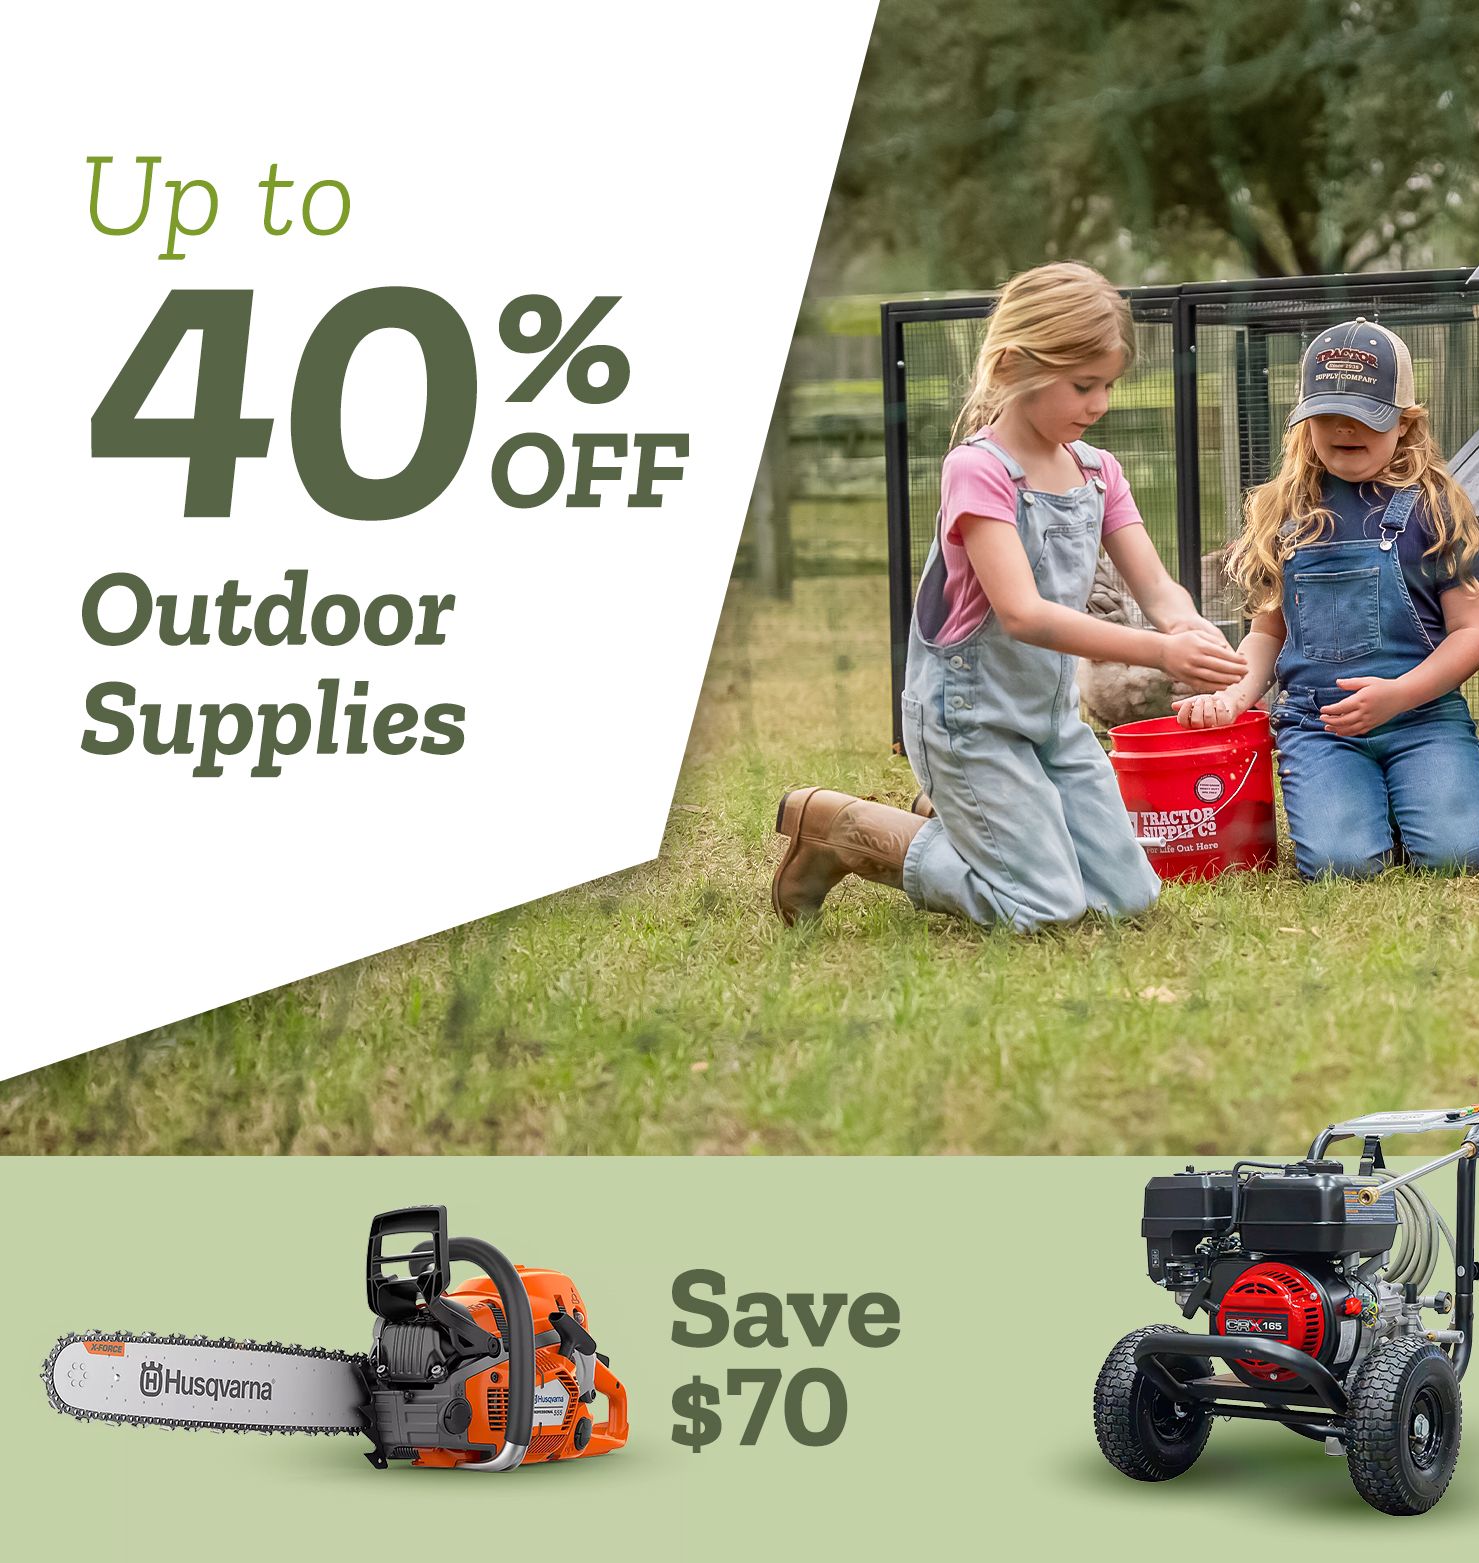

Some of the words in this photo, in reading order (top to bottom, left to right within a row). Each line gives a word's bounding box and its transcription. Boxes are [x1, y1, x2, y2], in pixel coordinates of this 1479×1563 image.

[1316, 348, 1378, 368] TRACTOR
[1316, 373, 1339, 381] SUPPLY
[1340, 373, 1378, 384] COMPANY
[1140, 807, 1215, 825] TRACTOR
[1143, 824, 1195, 839] SUPPLY
[1160, 844, 1175, 853] Life
[1177, 844, 1194, 853] Out
[1196, 841, 1219, 851] Here
[1226, 1318, 1263, 1332] CRX
[1262, 1321, 1282, 1331] 165
[90, 1343, 123, 1353] X-FORCE
[165, 1368, 273, 1402] Husqvarna
[538, 1395, 564, 1403] Husqvarna
